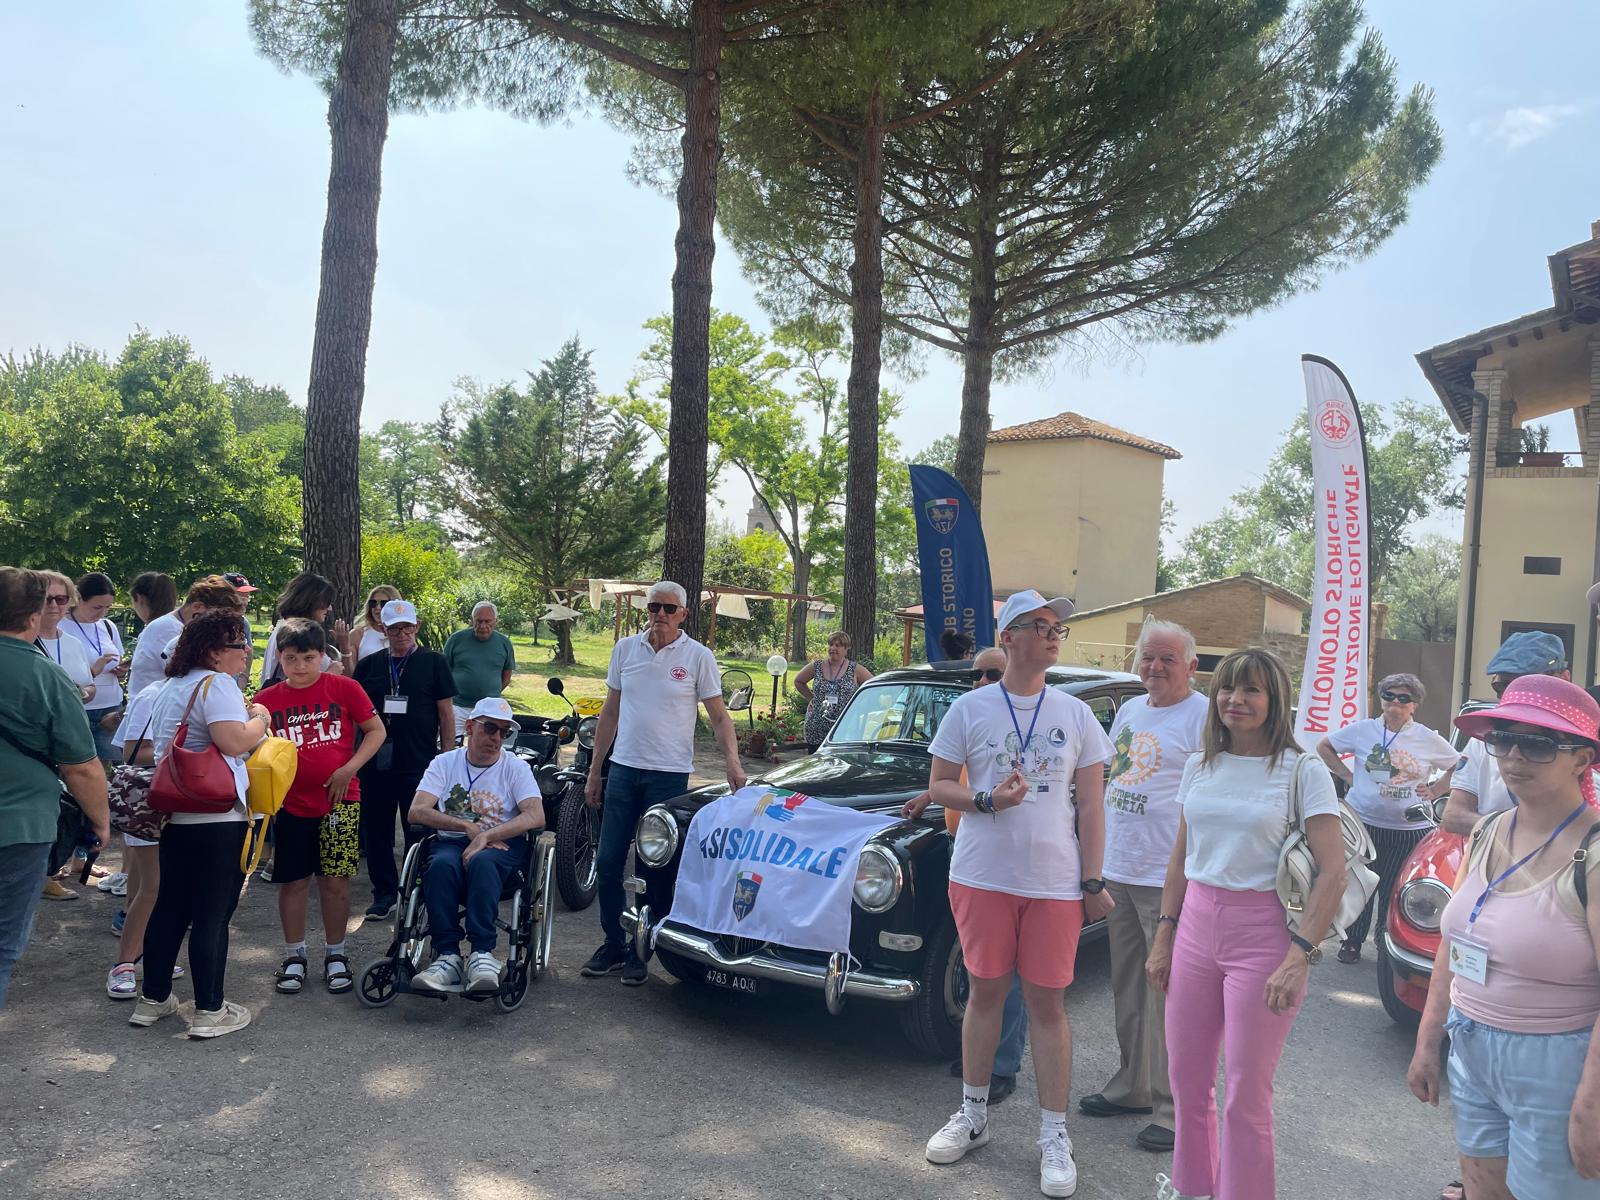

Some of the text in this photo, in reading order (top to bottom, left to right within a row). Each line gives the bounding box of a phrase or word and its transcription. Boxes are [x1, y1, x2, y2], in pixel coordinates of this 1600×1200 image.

[940, 548, 956, 612] STORICO
[287, 711, 329, 723] CHICAGO
[706, 970, 727, 985] 4783
